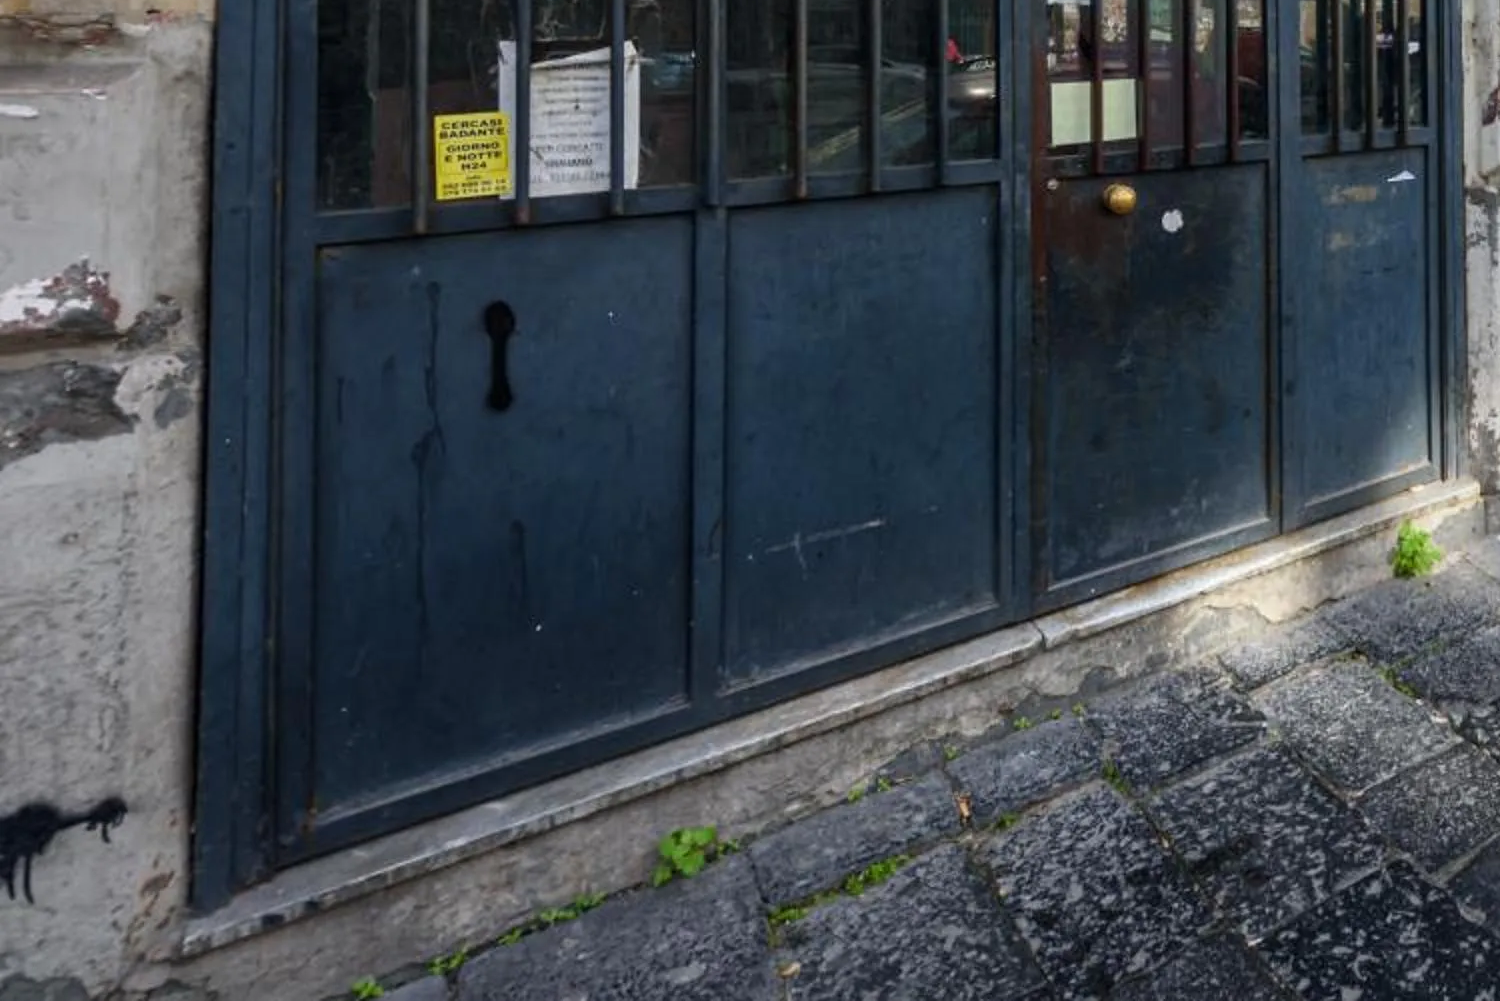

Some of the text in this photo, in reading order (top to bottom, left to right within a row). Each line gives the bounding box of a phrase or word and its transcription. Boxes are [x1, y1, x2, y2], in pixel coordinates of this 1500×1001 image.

[441, 119, 503, 129] CERCASI
[439, 127, 505, 139] BADANTE
[446, 141, 500, 152] GIORNO
[445, 151, 502, 162] E NOTTE
